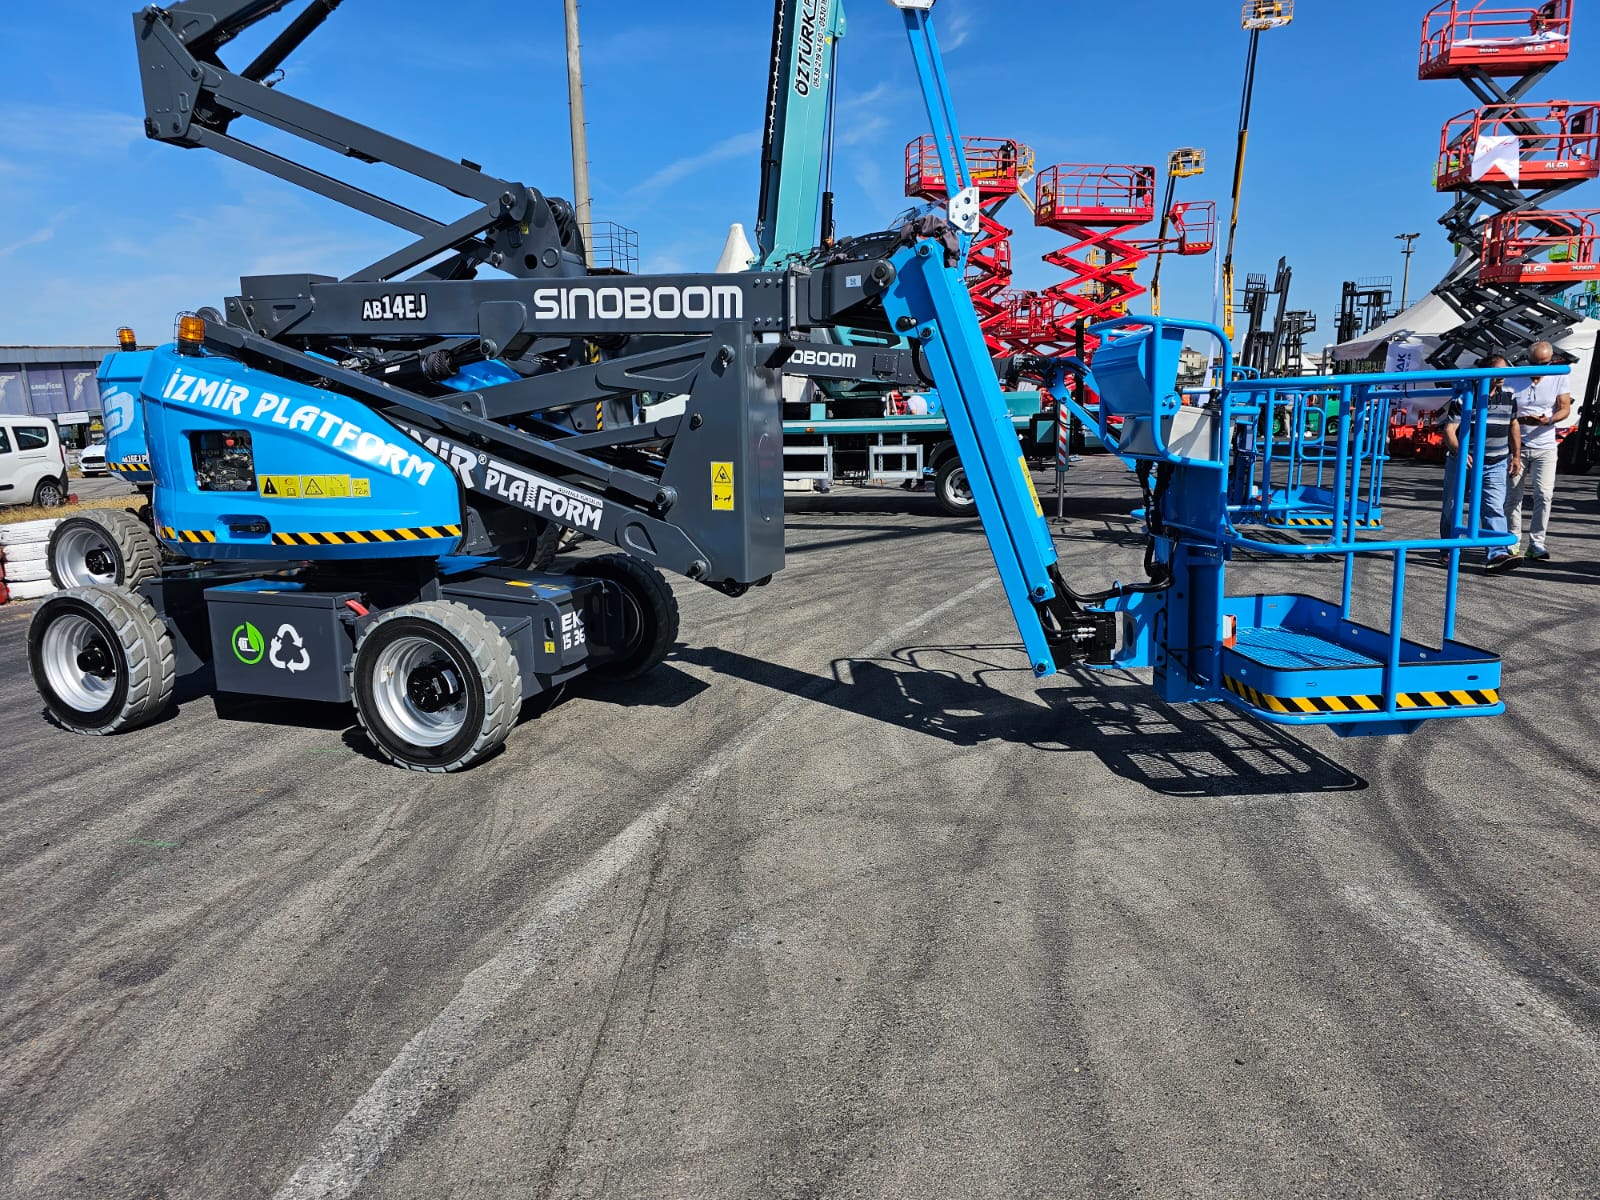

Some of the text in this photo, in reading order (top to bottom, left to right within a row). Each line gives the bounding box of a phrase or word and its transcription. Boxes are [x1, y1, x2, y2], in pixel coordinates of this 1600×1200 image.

[794, 9, 816, 96] ÖZTÜRK
[362, 294, 428, 320] AB14EJ
[533, 286, 743, 320] SINOBOOM
[787, 349, 857, 369] OBOOM
[162, 368, 436, 486] İZMİR PLATFORM
[484, 460, 603, 531] PLATFORM
[561, 608, 585, 633] EK
